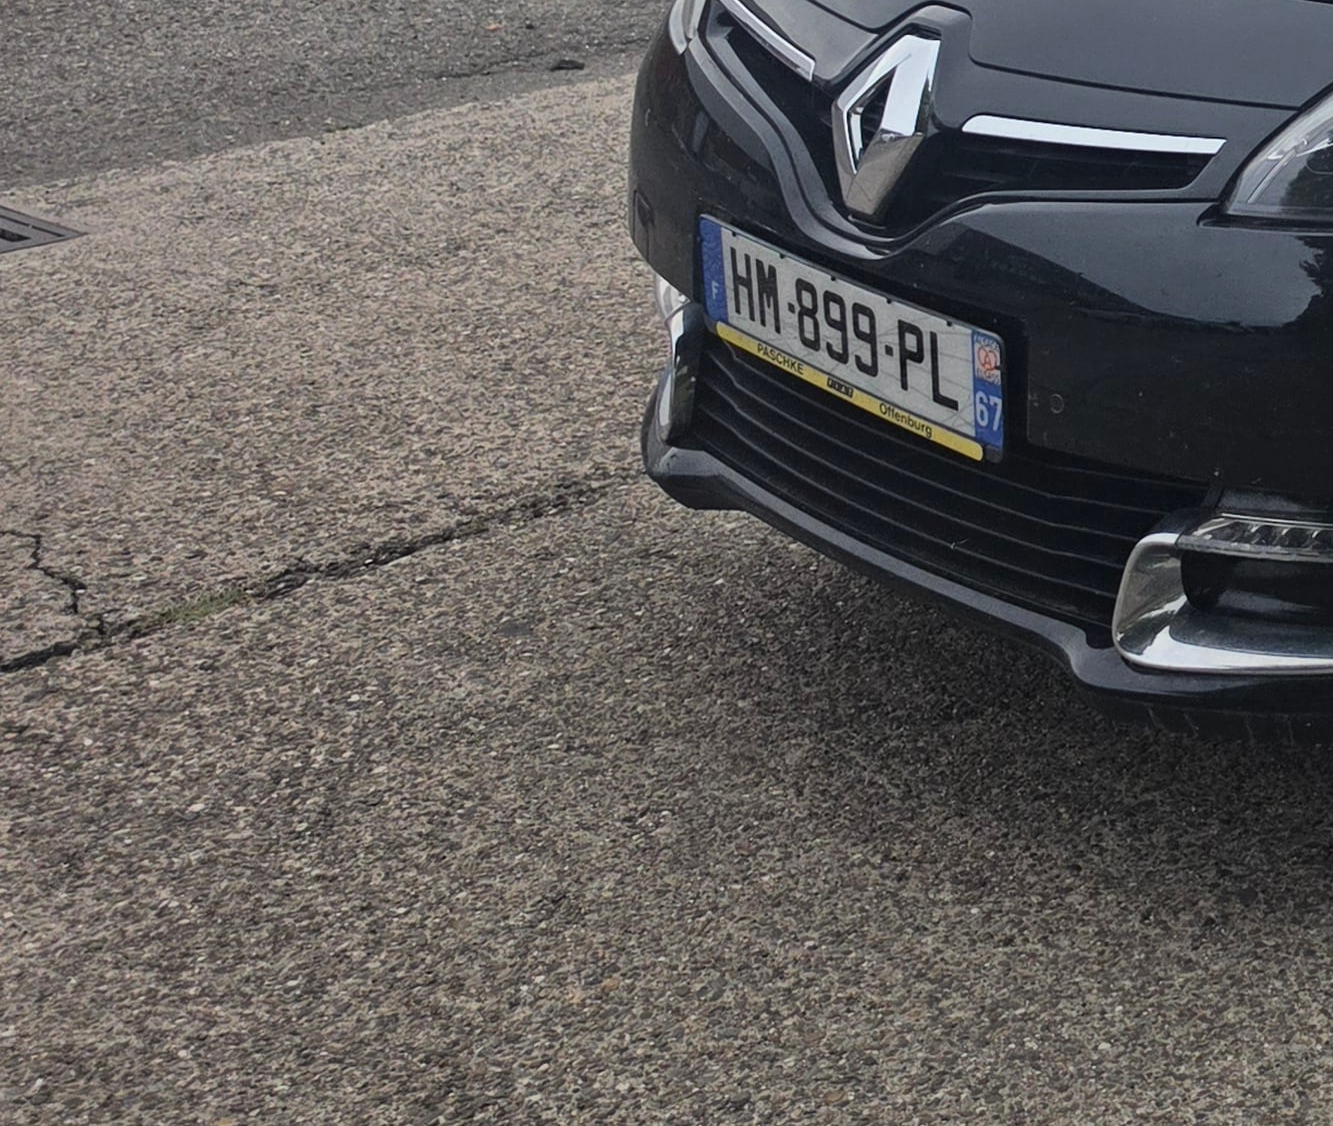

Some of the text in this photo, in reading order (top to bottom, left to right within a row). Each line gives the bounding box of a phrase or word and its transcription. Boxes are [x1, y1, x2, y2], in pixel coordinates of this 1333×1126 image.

[711, 280, 719, 299] F
[757, 343, 804, 376] PASCHKE
[879, 402, 933, 439] Offenburg
[975, 390, 1002, 431] 67
